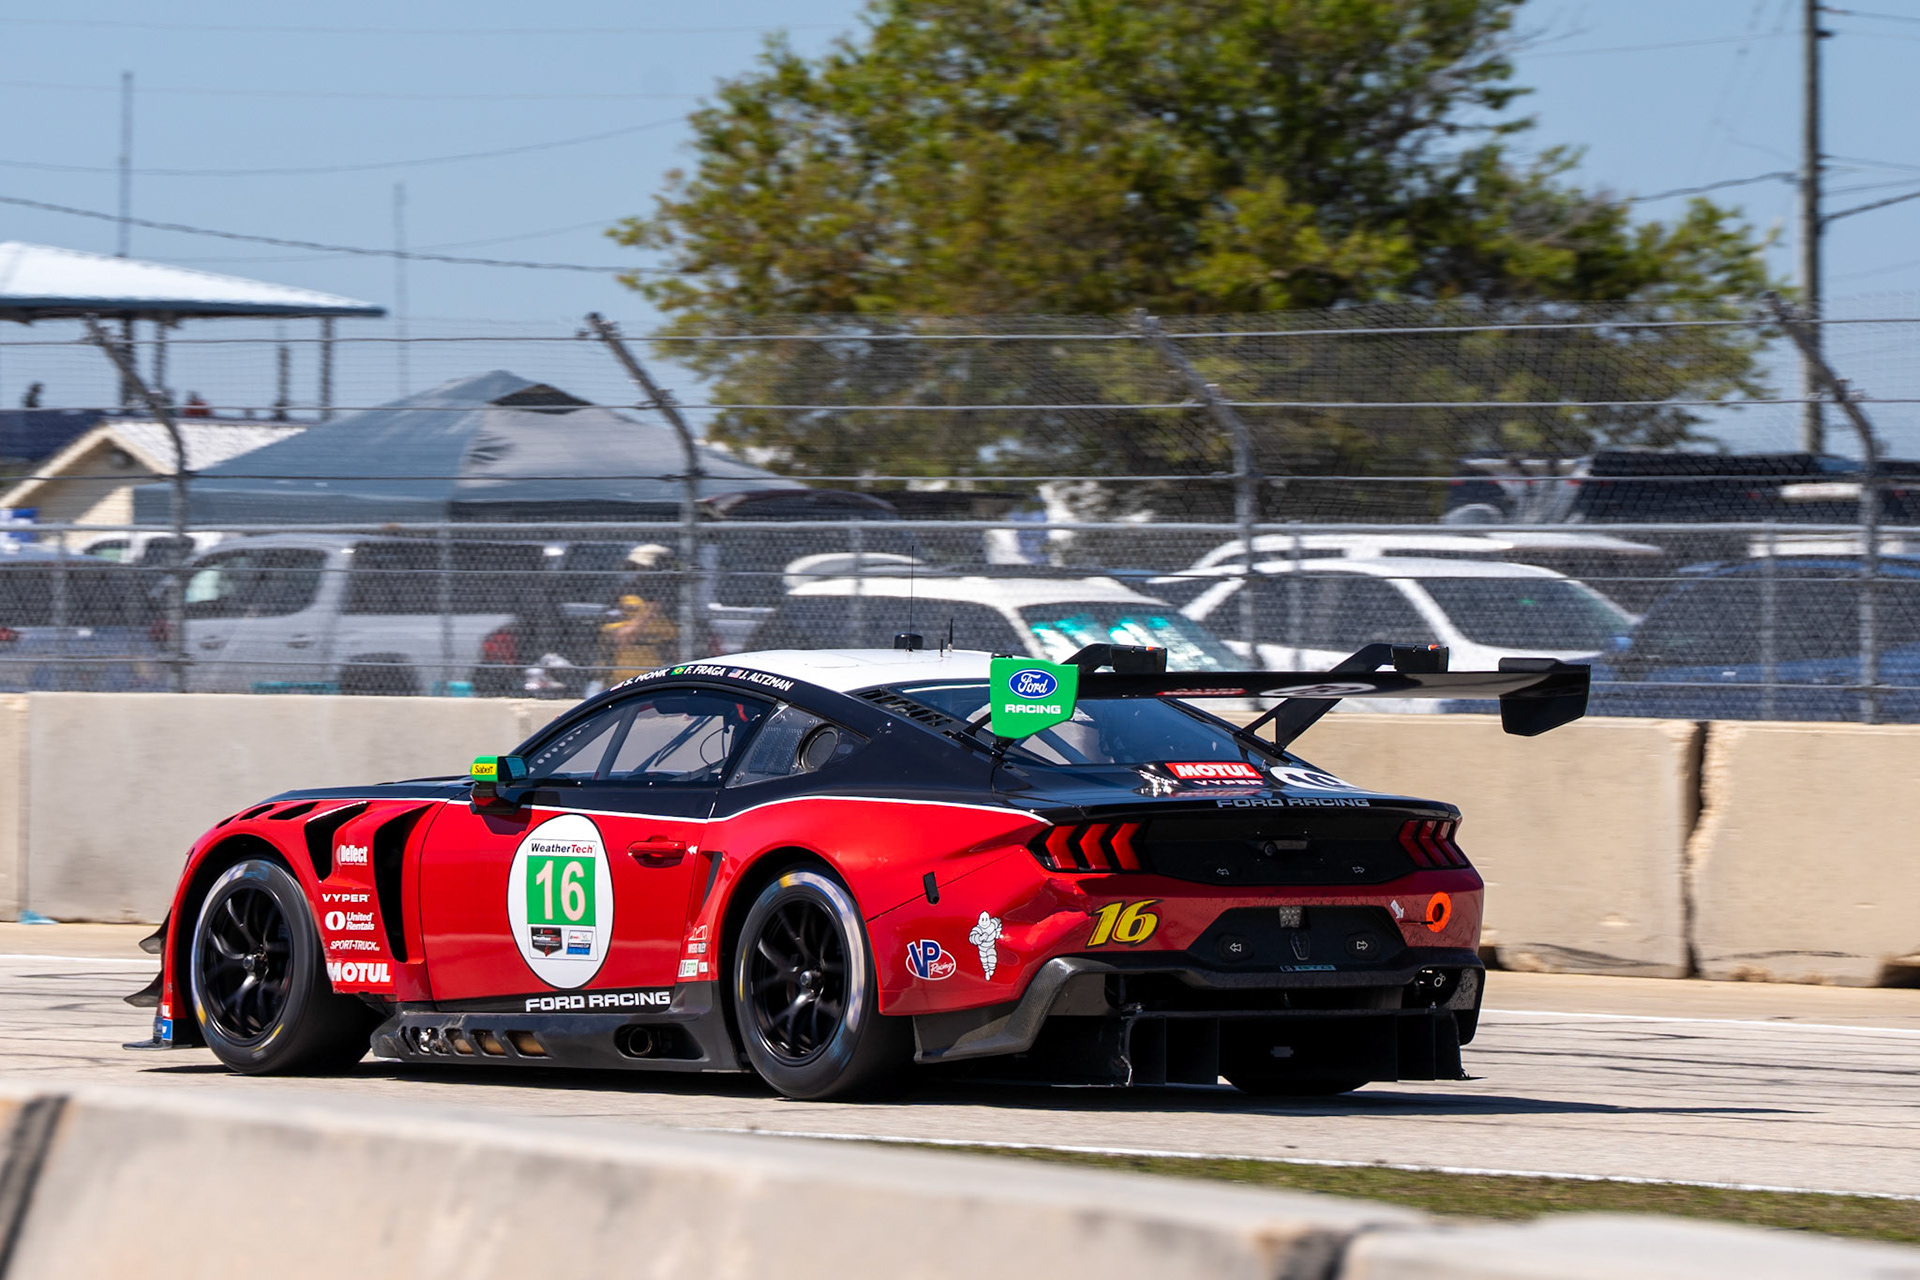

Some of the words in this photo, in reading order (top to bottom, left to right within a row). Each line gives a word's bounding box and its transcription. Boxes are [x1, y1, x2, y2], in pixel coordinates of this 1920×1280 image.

[634, 668, 670, 683] MONK
[683, 665, 694, 675] F.
[693, 665, 727, 677] FRAGA
[739, 671, 749, 680] J.
[747, 672, 795, 692] ALTZMAN
[1017, 673, 1049, 694] Ford
[1005, 704, 1062, 715] RACING
[1177, 764, 1257, 778] MOTUL
[1216, 799, 1284, 808] FORD
[1288, 798, 1370, 807] RACING
[531, 843, 594, 854] WeatherTech
[321, 893, 369, 903] VYPER
[535, 860, 586, 922] 16
[345, 912, 372, 922] United
[1086, 898, 1162, 948] 16
[345, 921, 375, 931] Rentals
[907, 939, 941, 978] VP
[327, 962, 391, 983] MOTUL
[930, 962, 954, 975] Racing
[525, 995, 585, 1012] FORD
[589, 991, 671, 1008] RACING
